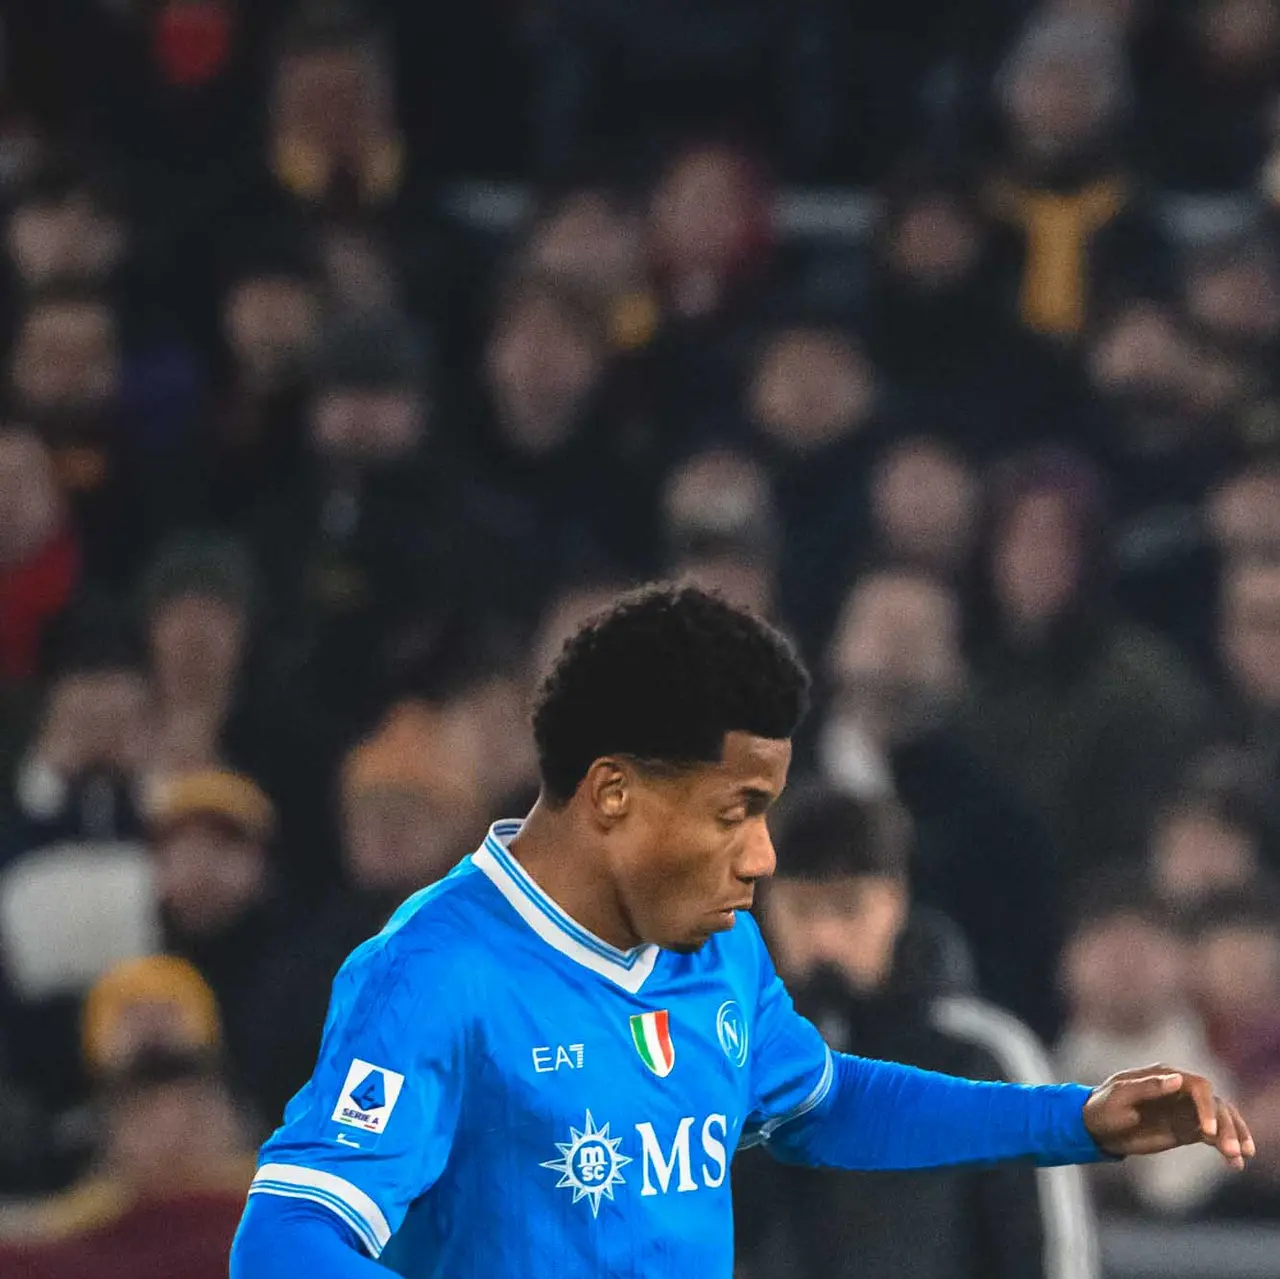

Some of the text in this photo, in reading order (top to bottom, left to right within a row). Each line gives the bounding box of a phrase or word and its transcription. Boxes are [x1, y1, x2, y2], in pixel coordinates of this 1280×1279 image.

[532, 1043, 585, 1073] EA7
[342, 1107, 380, 1125] SERIE A
[634, 1112, 739, 1196] MS
